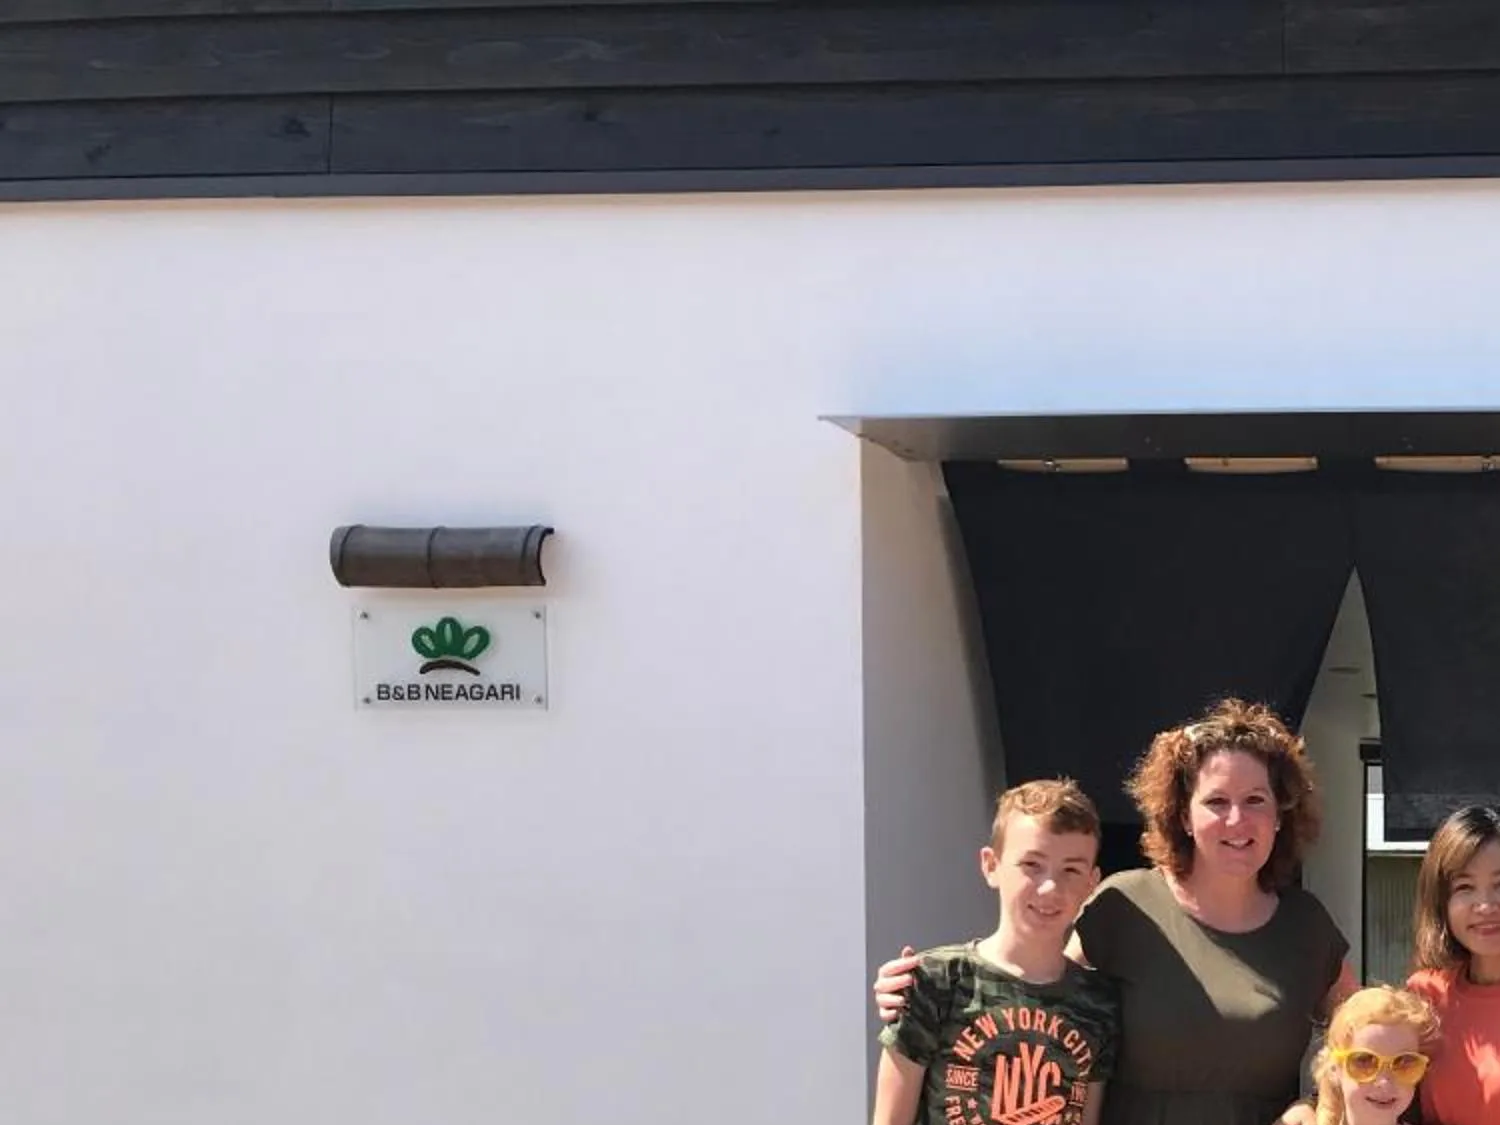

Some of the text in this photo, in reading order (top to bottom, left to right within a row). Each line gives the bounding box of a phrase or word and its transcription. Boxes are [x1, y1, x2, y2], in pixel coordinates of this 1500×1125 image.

[376, 684, 521, 701] B&B NEAGARI
[953, 1007, 1093, 1077] NEW YORK CITY
